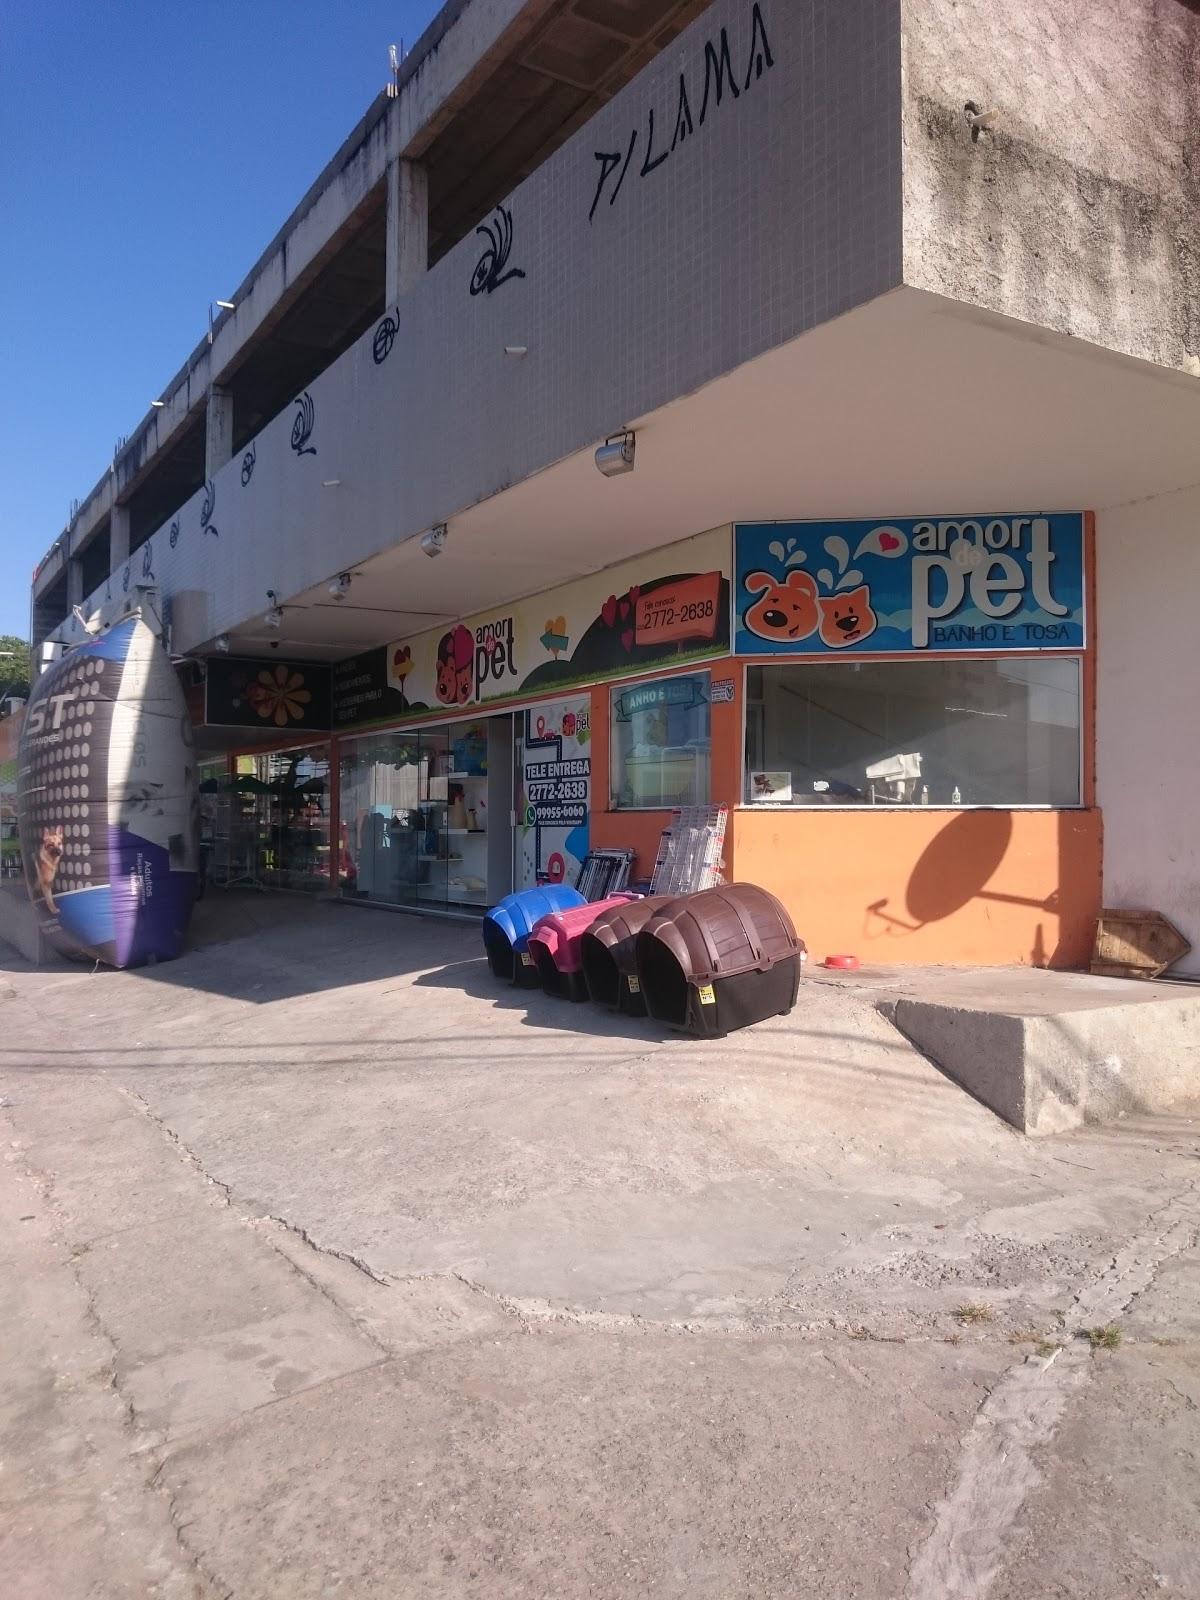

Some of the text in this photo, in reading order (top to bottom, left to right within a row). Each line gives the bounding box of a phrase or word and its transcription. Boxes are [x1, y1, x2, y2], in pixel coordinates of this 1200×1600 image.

[912, 519, 1031, 550] amor
[957, 546, 982, 566] de
[912, 518, 1068, 647] pet
[644, 600, 713, 629] 2772-2638
[476, 619, 508, 644] amor
[934, 624, 1070, 642] BANHO E TOSA
[486, 638, 495, 652] de
[475, 617, 518, 701] pet
[526, 760, 590, 779] TELE ENTREGA
[529, 782, 585, 800] 2772-2638
[536, 805, 584, 819] 99955-6060
